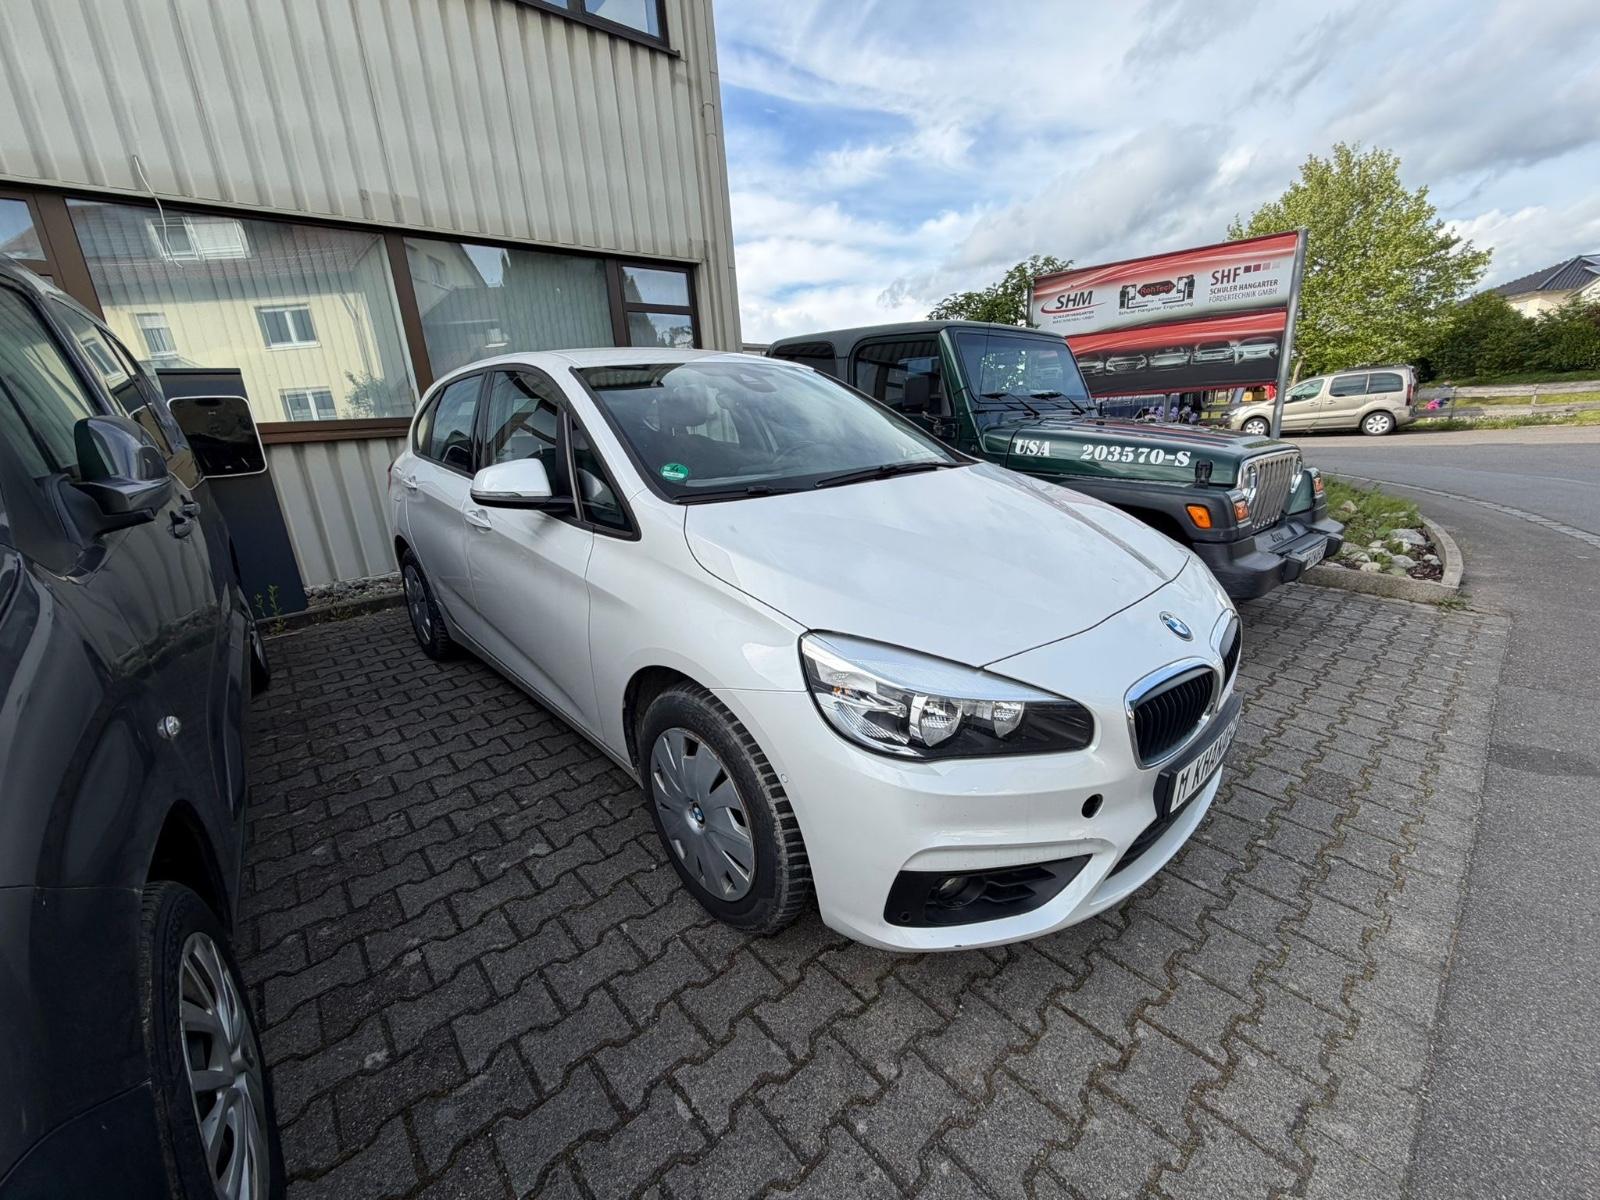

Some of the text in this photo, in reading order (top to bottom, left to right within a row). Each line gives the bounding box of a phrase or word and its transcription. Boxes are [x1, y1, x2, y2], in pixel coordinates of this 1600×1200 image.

[1210, 266, 1241, 286] SHF
[1238, 279, 1278, 291] HANGARTER
[1055, 290, 1093, 309] SHM
[1014, 439, 1192, 467] USA 203570-S
